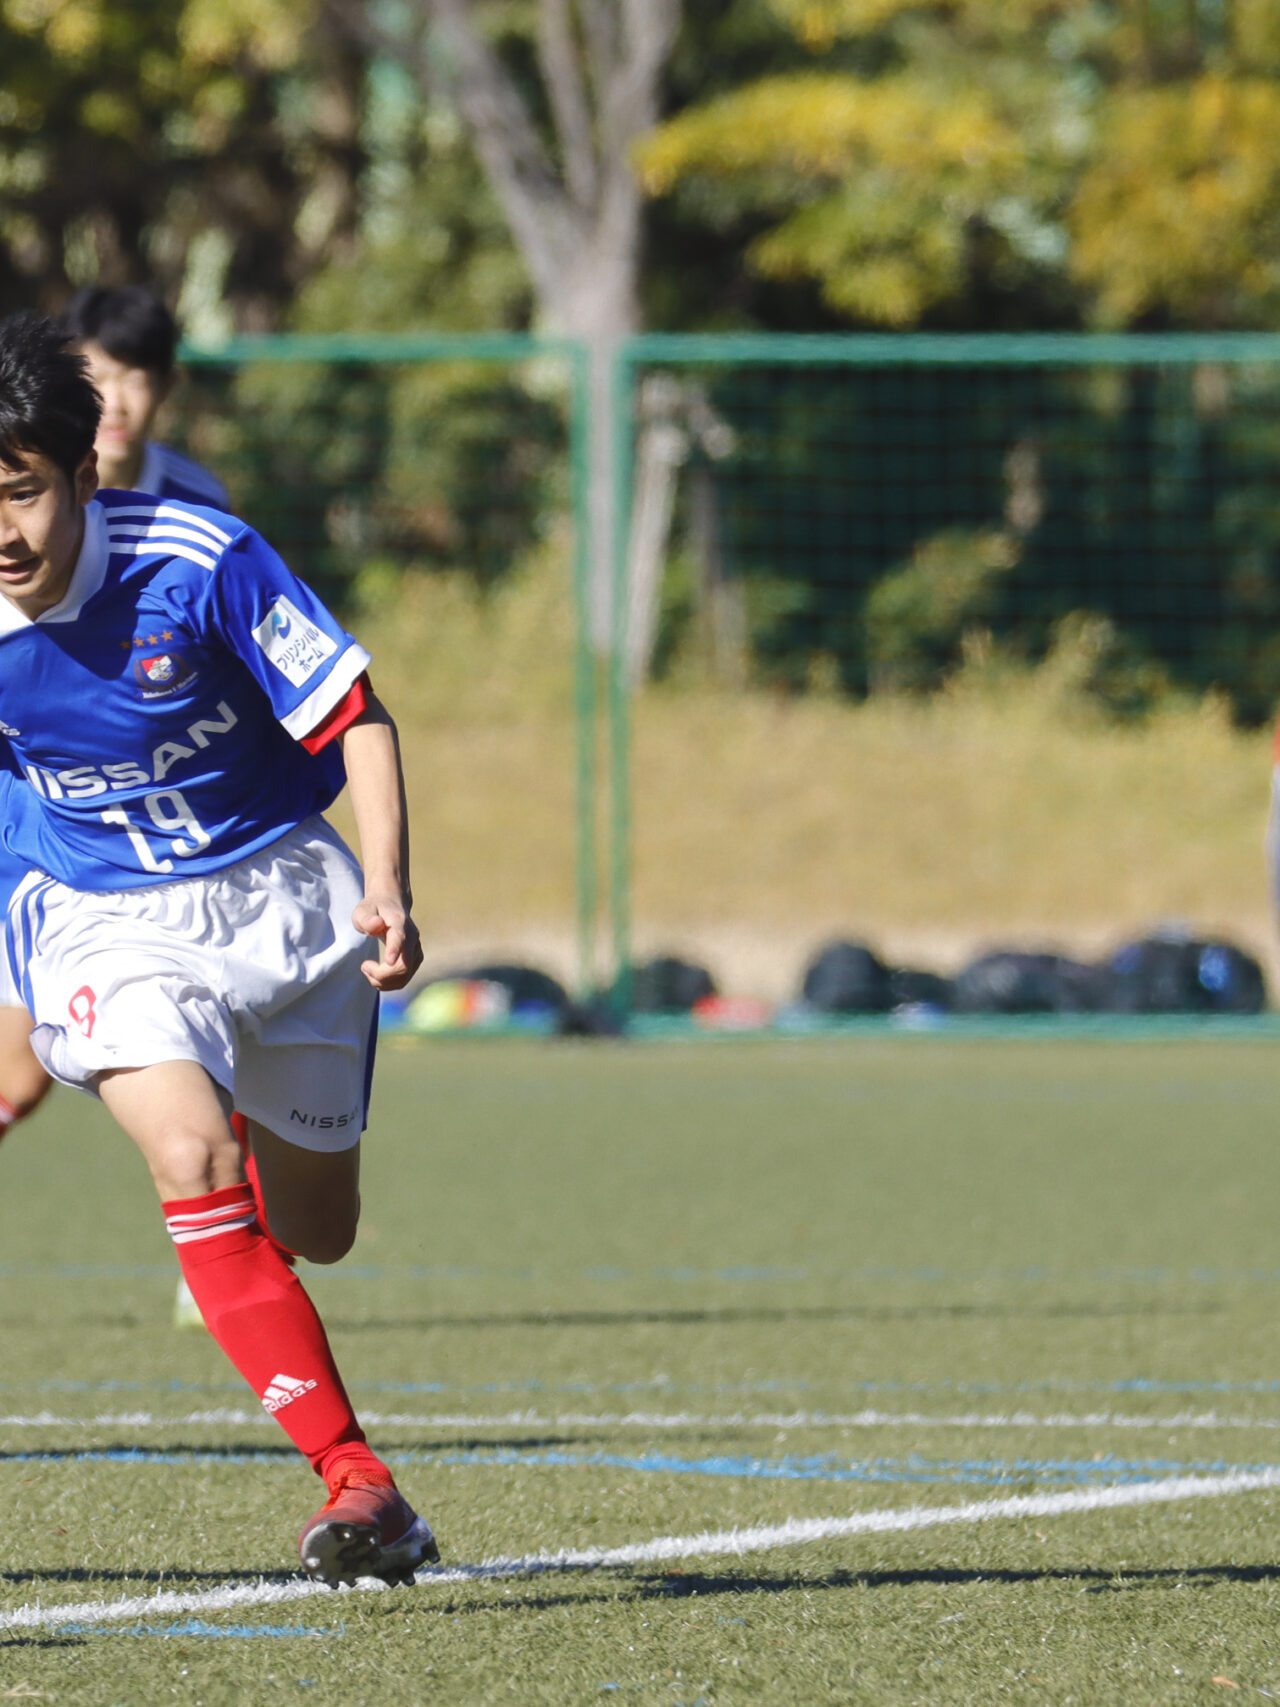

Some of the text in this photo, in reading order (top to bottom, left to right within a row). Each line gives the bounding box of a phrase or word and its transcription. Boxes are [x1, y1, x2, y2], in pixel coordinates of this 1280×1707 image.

[298, 646, 325, 673] ホーム
[100, 789, 212, 874] 19
